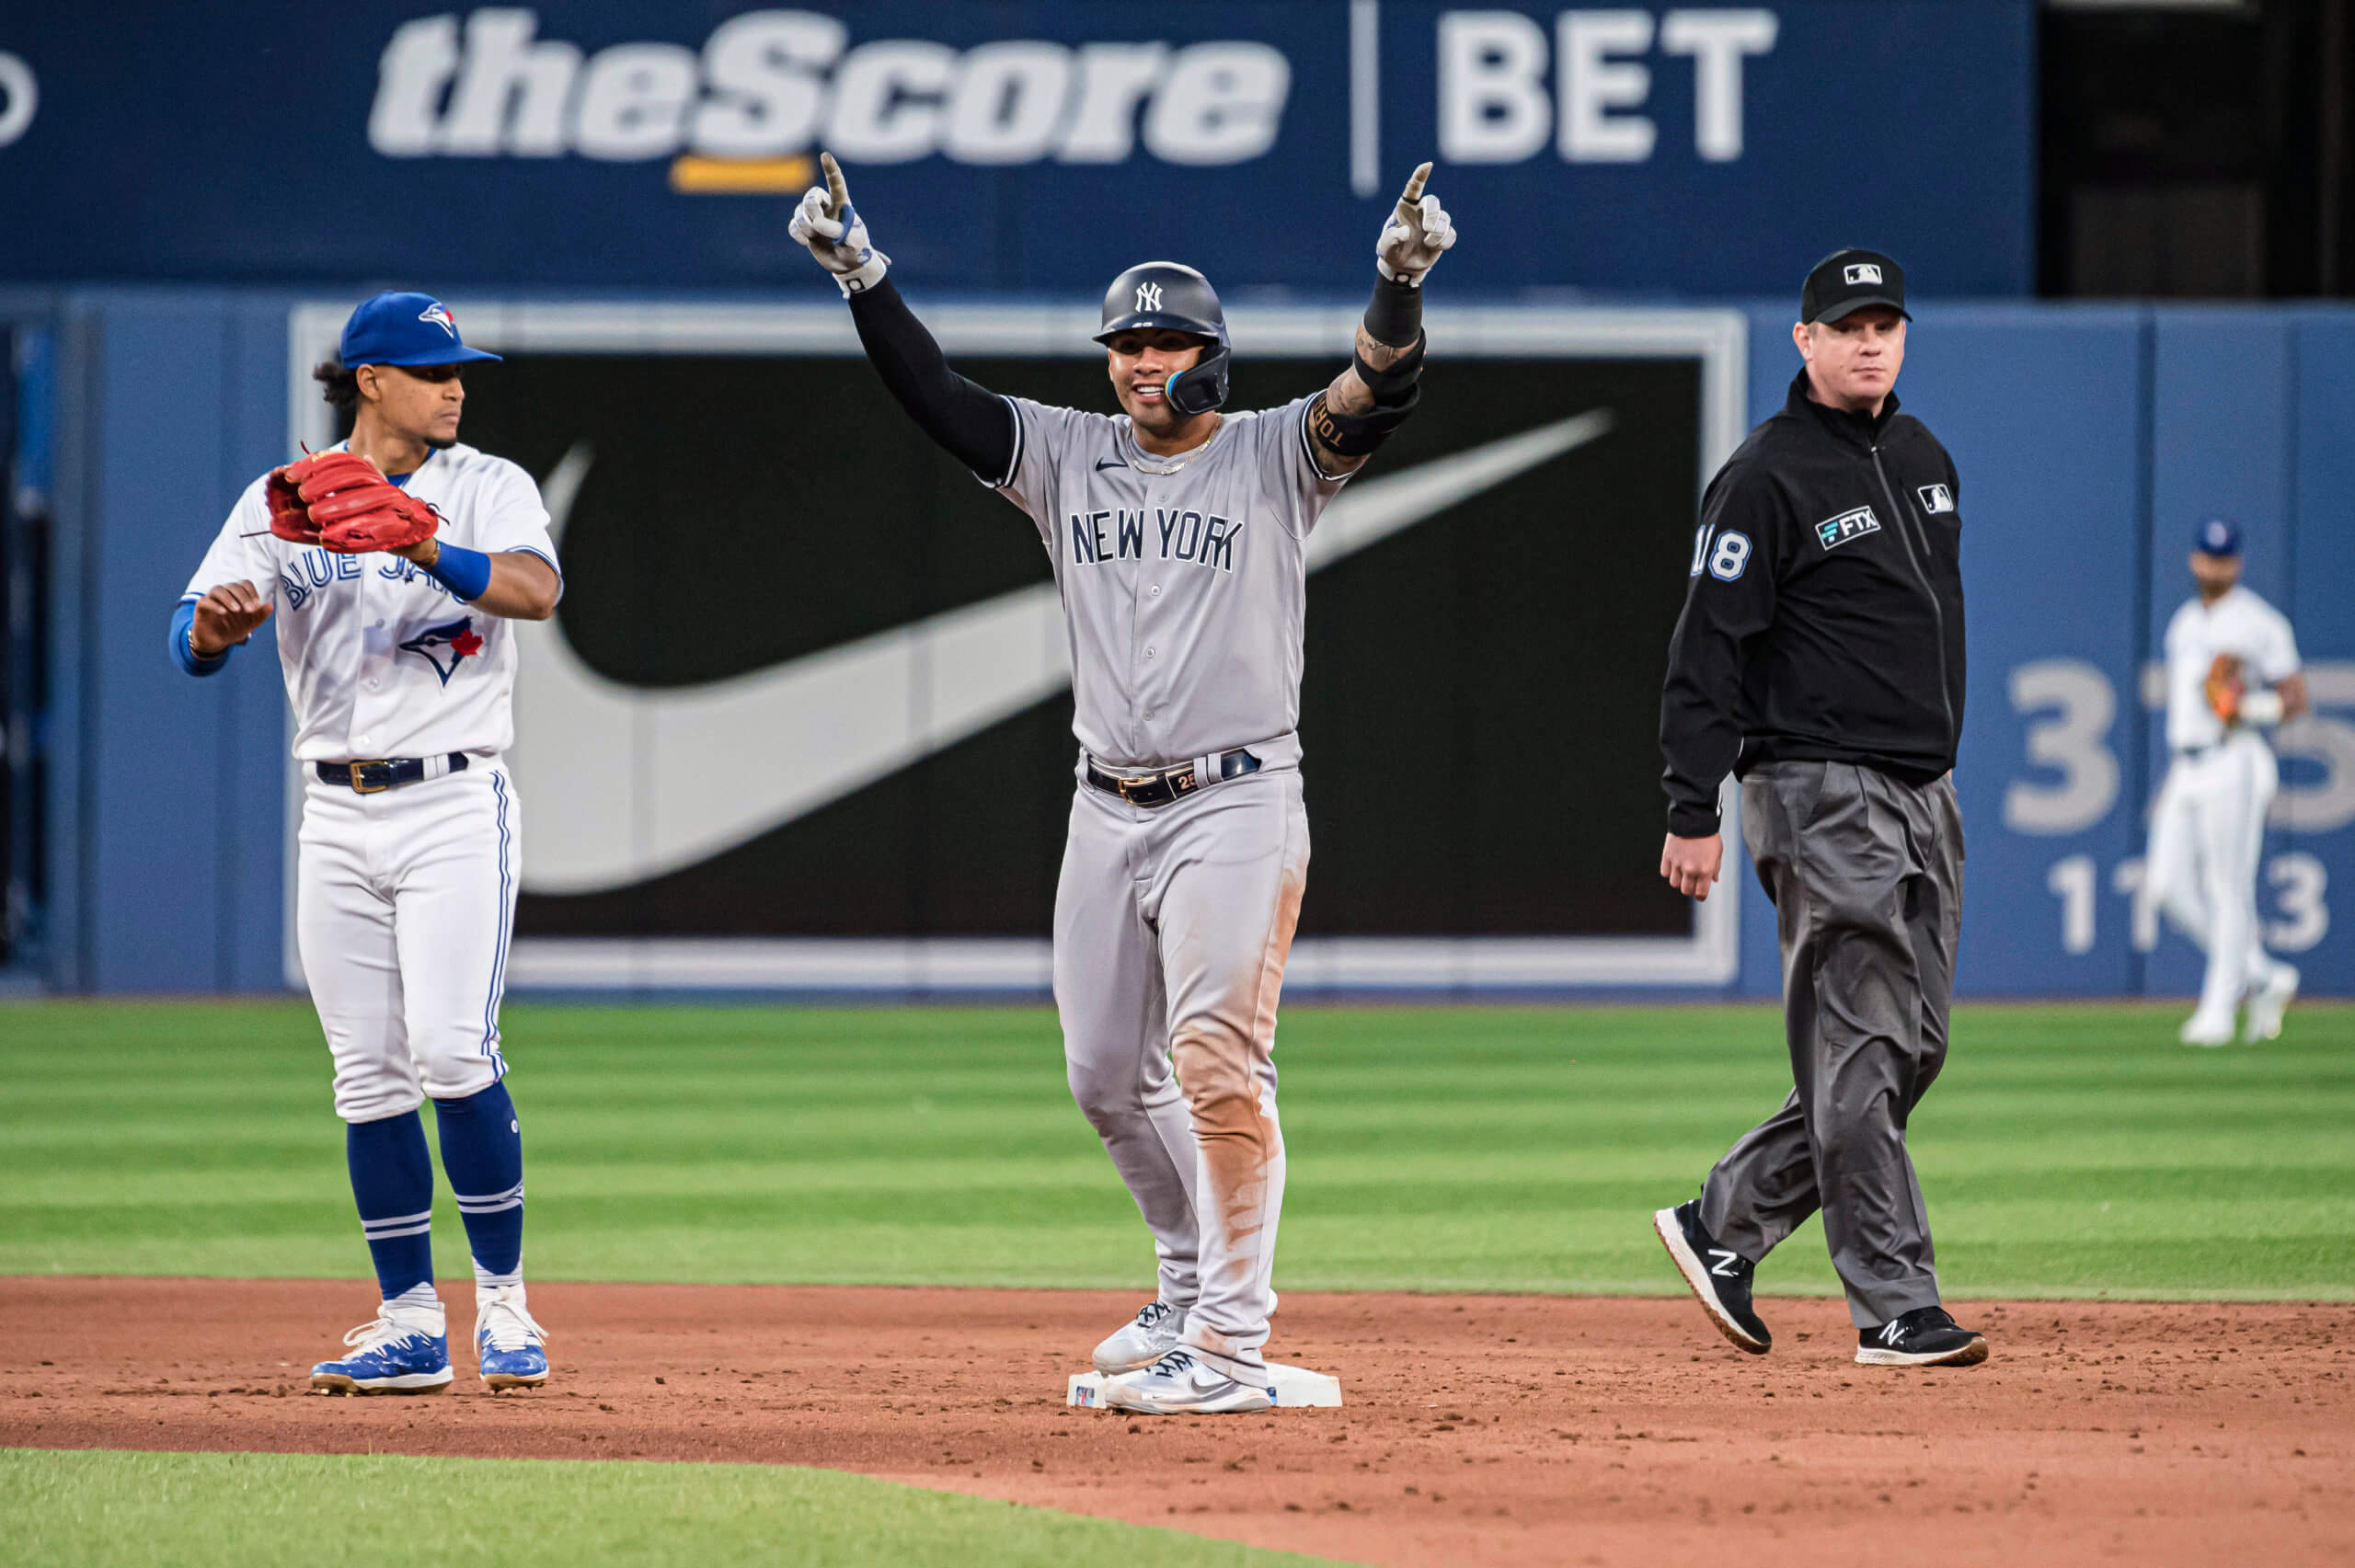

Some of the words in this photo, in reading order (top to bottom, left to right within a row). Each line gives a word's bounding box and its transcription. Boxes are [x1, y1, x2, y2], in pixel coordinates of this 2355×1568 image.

[368, 7, 1292, 166] theScore
[1437, 8, 1779, 165] BET
[1070, 508, 1144, 567] NEW
[1155, 507, 1245, 574] YORK
[1839, 509, 1878, 537] FTX
[280, 548, 362, 612] BLUE
[2004, 659, 2355, 835] 35
